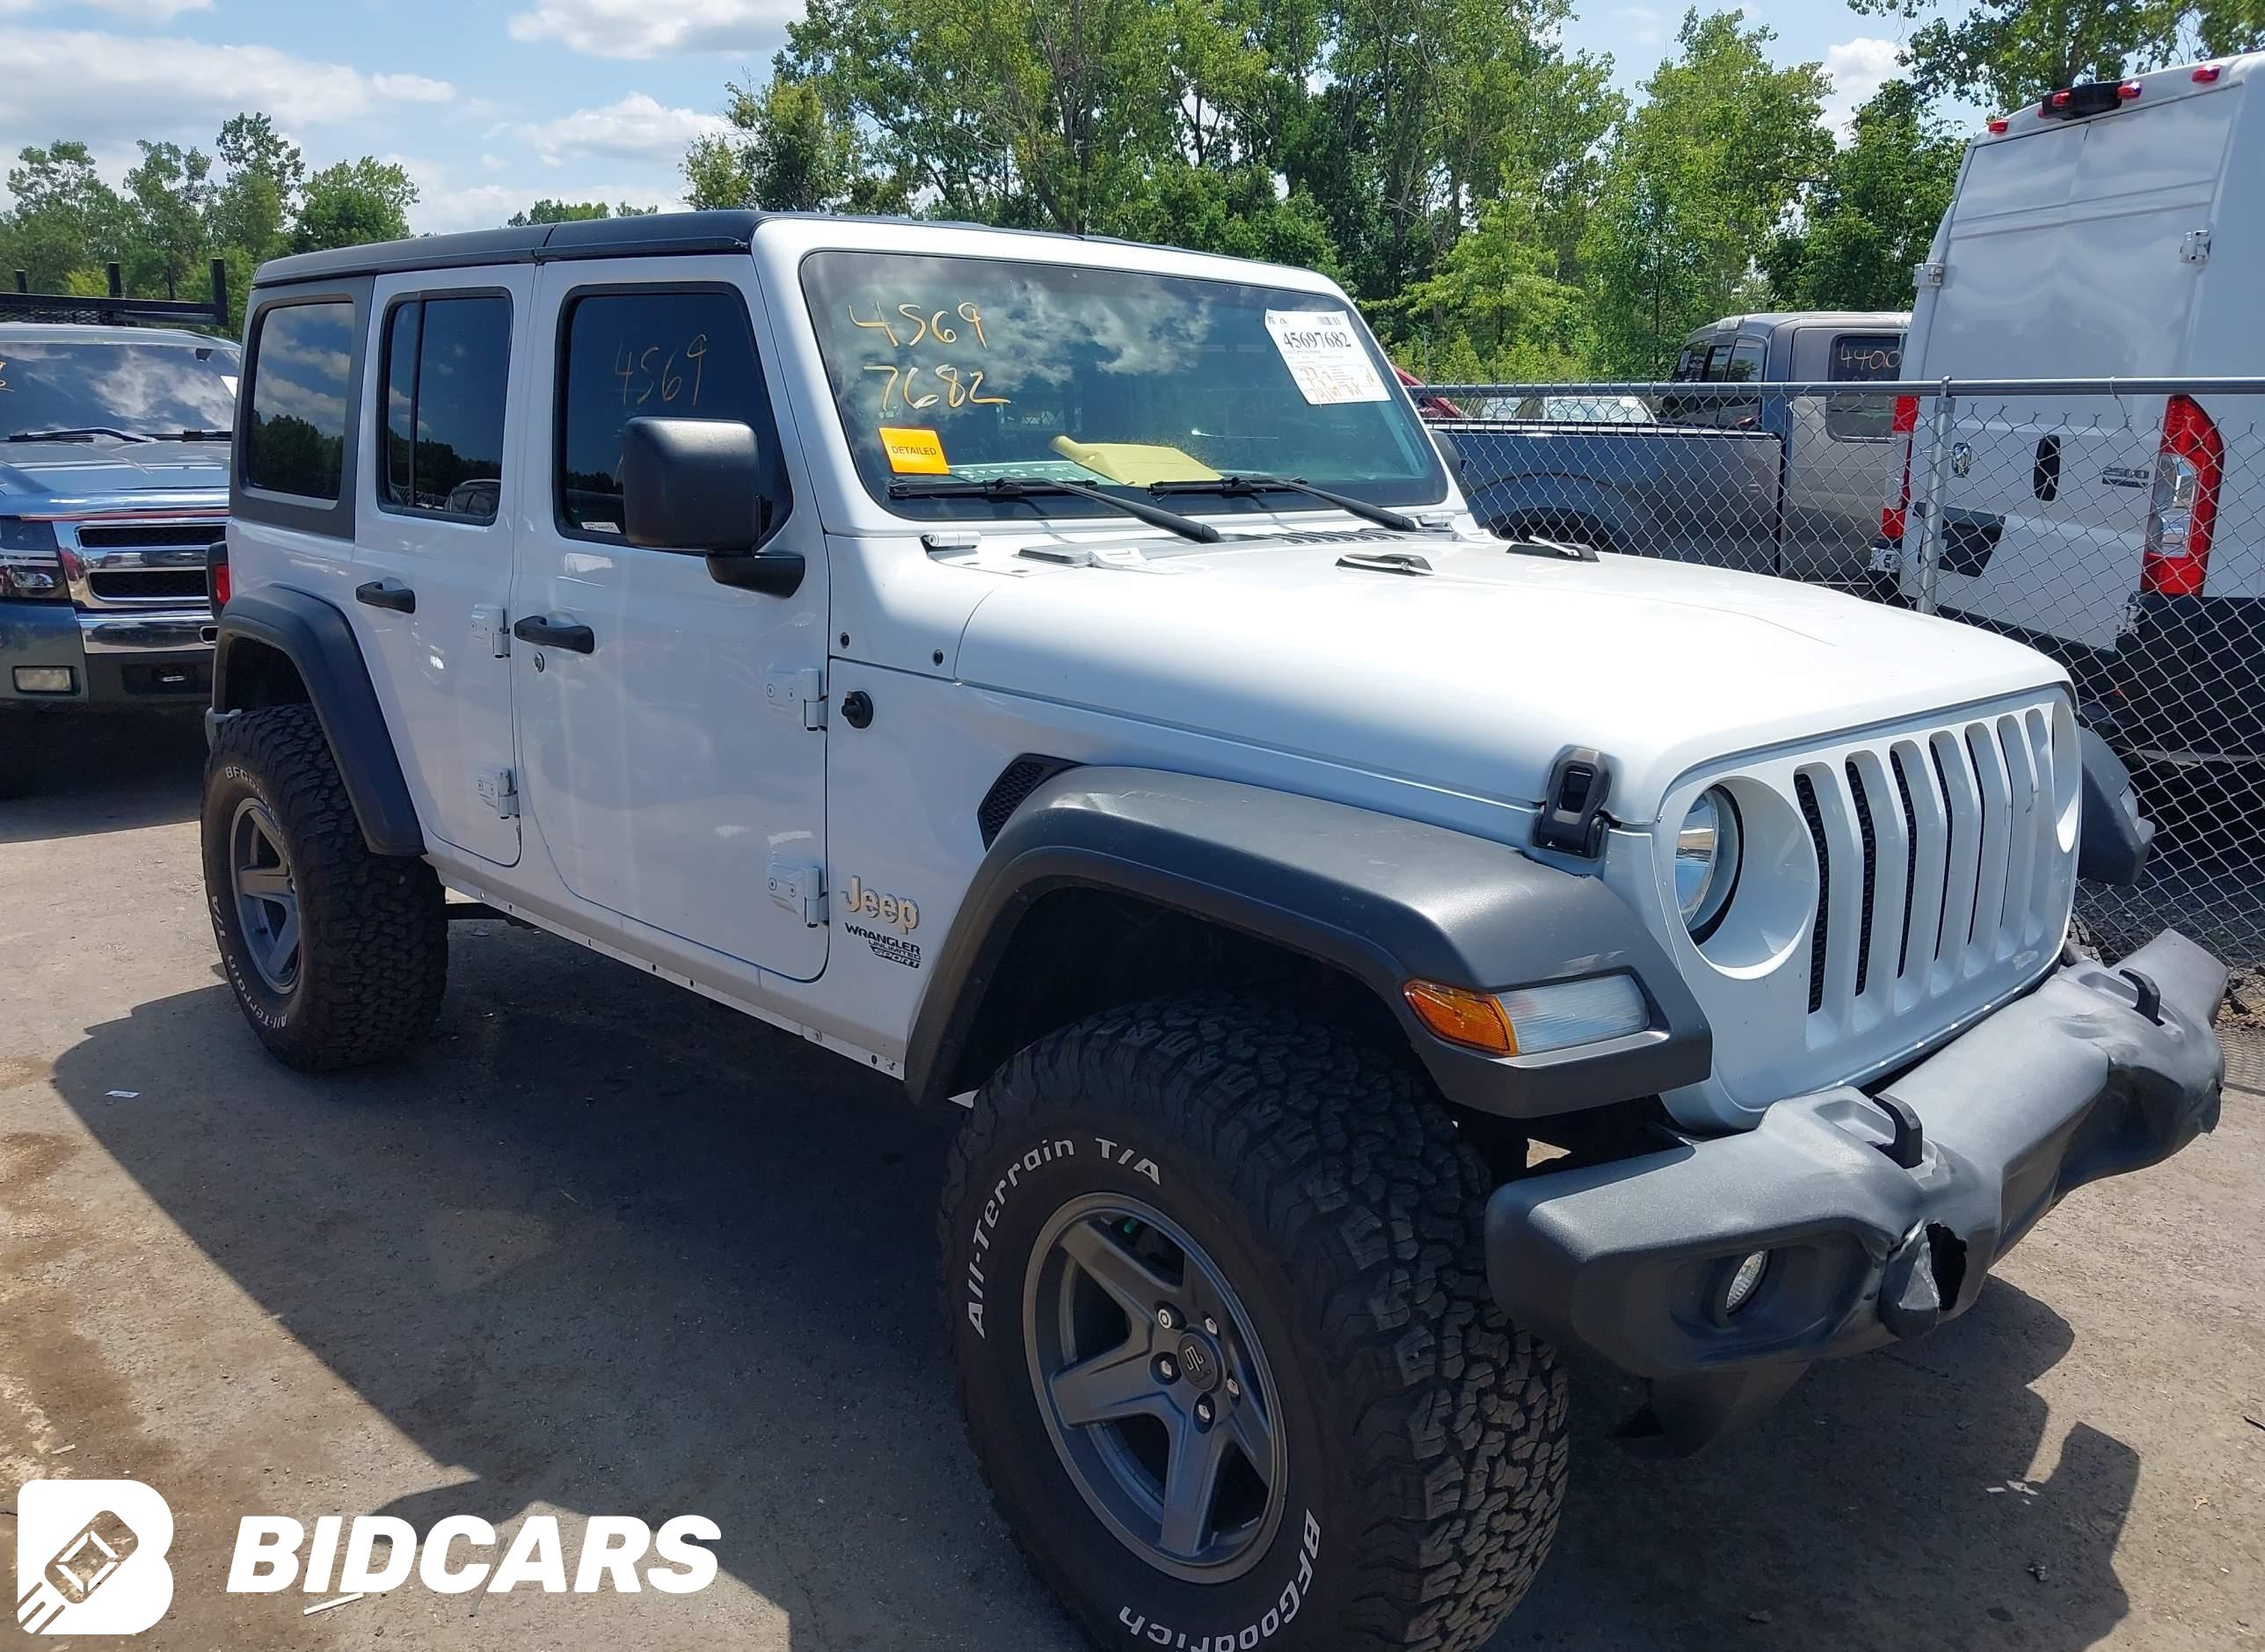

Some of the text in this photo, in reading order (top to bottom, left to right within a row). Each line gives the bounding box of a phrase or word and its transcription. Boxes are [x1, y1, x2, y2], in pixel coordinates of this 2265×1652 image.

[848, 300, 988, 350] 4569
[1284, 331, 1351, 348] 45697682
[615, 333, 707, 407] 4569
[863, 364, 1012, 410] 7682
[891, 445, 937, 456] DETAILED
[840, 874, 920, 935] Jeep
[844, 921, 921, 956] WRANGLER
[868, 938, 921, 961] UNLIMITED
[873, 948, 919, 968] SPORT
[968, 1138, 1161, 1340] All-Terrain T/A
